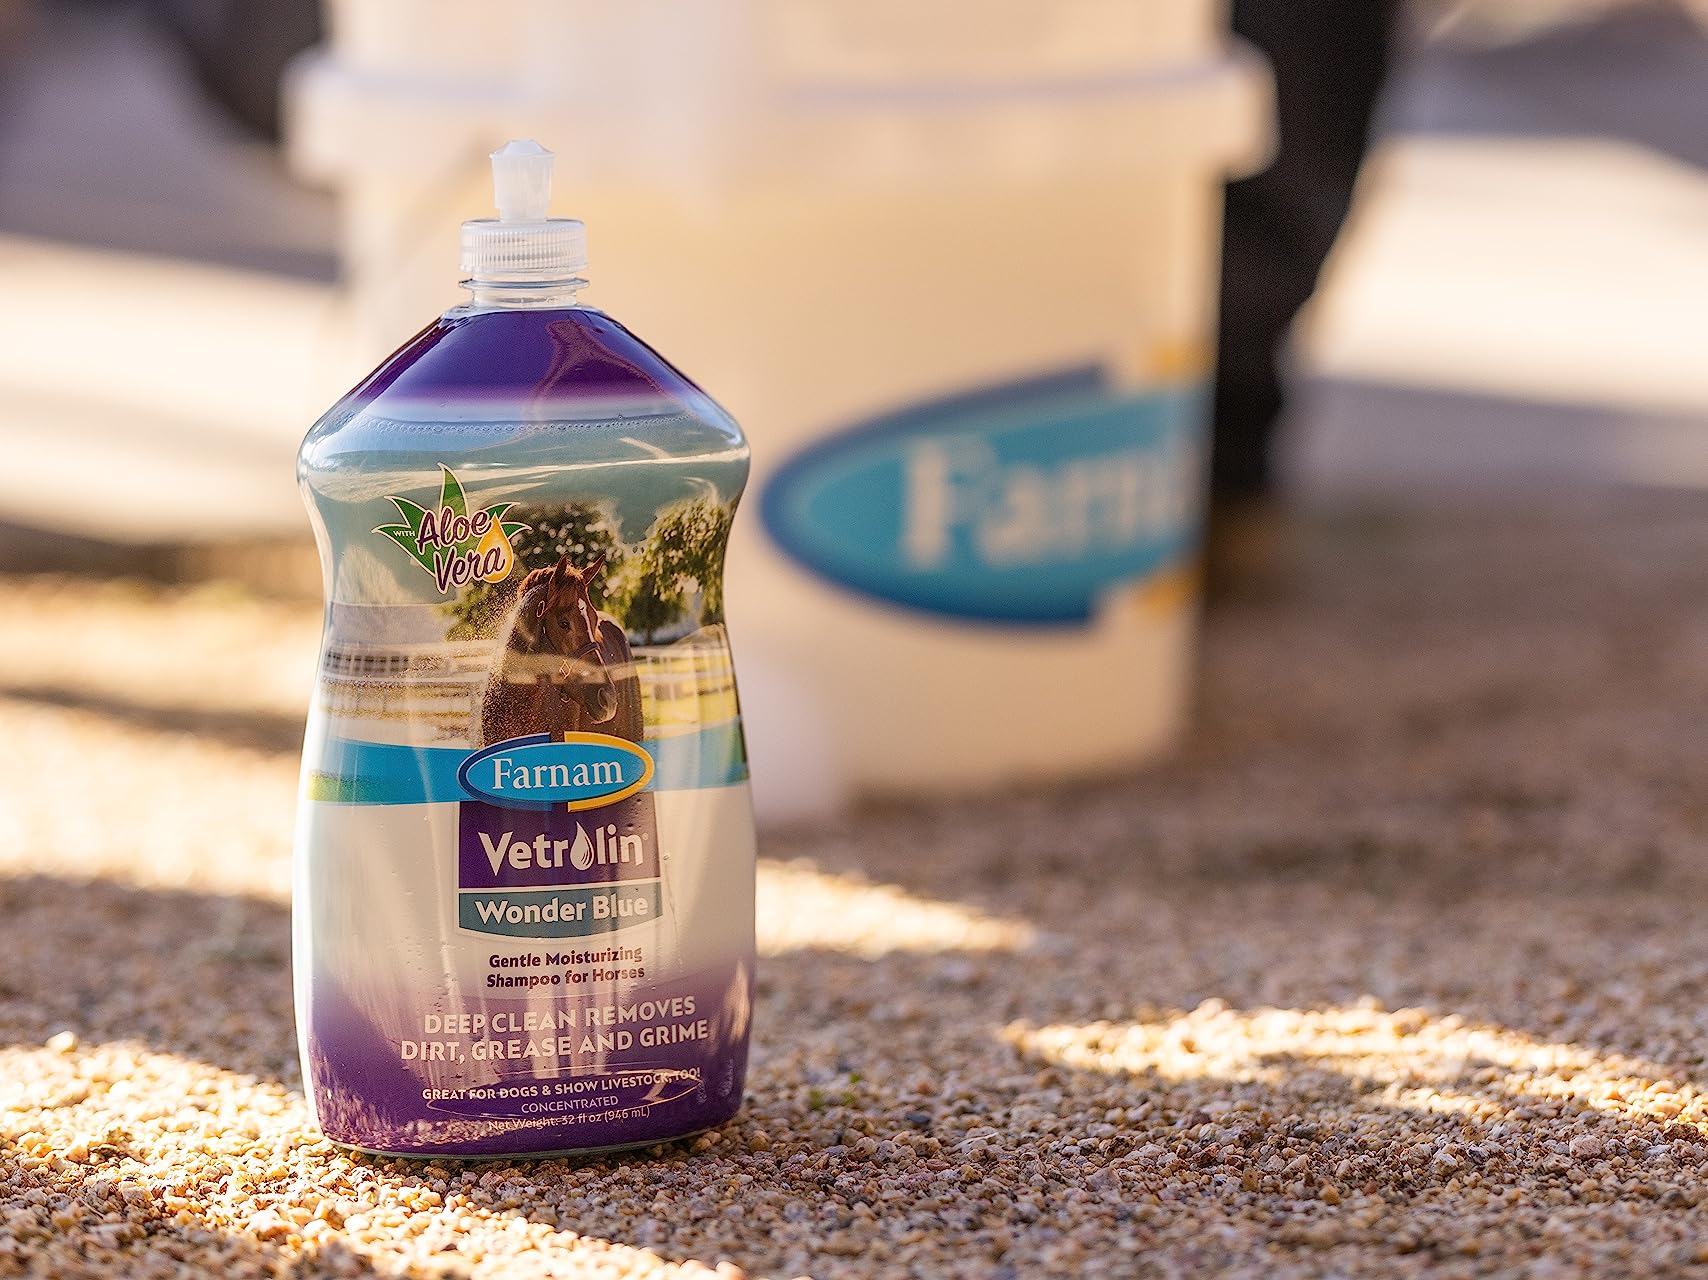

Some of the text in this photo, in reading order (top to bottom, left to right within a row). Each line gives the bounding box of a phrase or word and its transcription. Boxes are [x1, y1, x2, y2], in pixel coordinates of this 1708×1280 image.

[416, 507, 492, 554] Aloe
[434, 547, 506, 593] Vera
[492, 757, 624, 789] Farnam
[475, 893, 649, 925] Wonder Blue
[489, 946, 643, 968] Gentle Moisturizing
[487, 967, 645, 989] Shampoo for Horses
[424, 995, 696, 1034] DEEP CLEAN REMOVES
[401, 1019, 709, 1065] DIRT, GREASE AND GRIME
[422, 1067, 701, 1100] GREAT FOR DOGS & SHOW LIVESTOCK, TOO!
[488, 1120, 510, 1131] Net
[562, 1114, 575, 1126] 32
[578, 1112, 586, 1124] fl
[590, 1113, 602, 1123] oz
[604, 1108, 629, 1123] (946
[521, 1095, 619, 1114] CONCENTRATED
